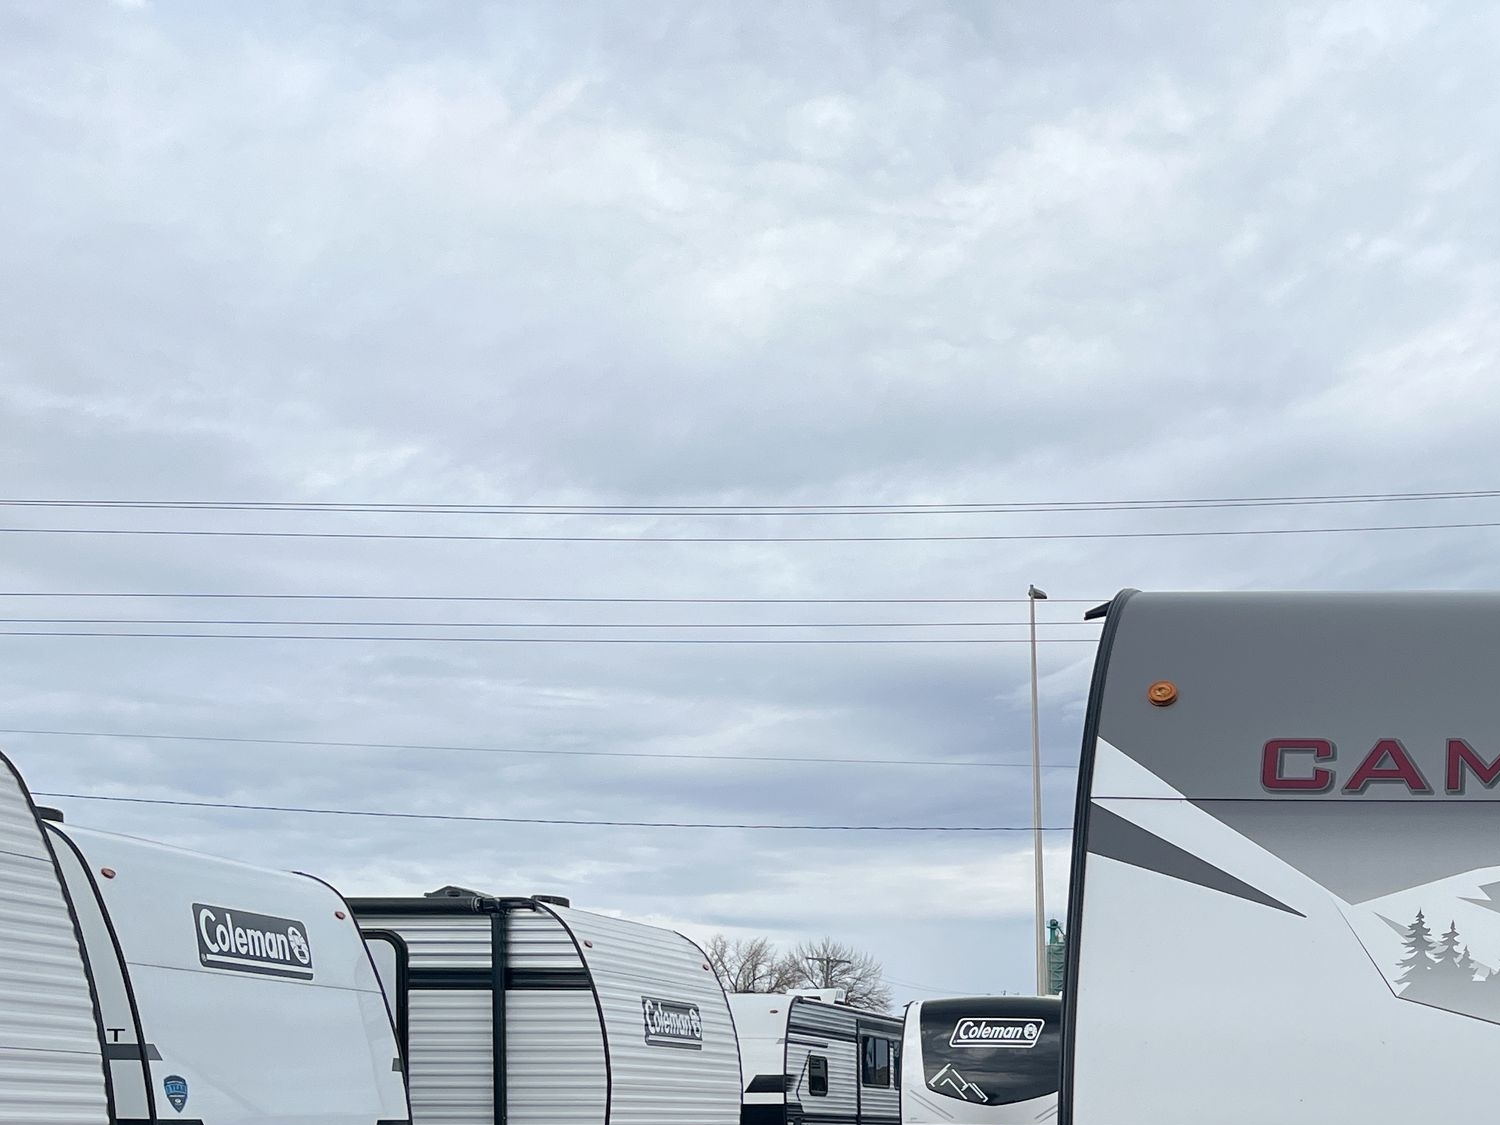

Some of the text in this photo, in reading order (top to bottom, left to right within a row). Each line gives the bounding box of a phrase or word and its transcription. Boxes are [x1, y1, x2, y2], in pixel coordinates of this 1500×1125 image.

[199, 908, 291, 961] Coleman
[645, 999, 692, 1036] Coleman
[959, 1021, 1023, 1040] Coleman
